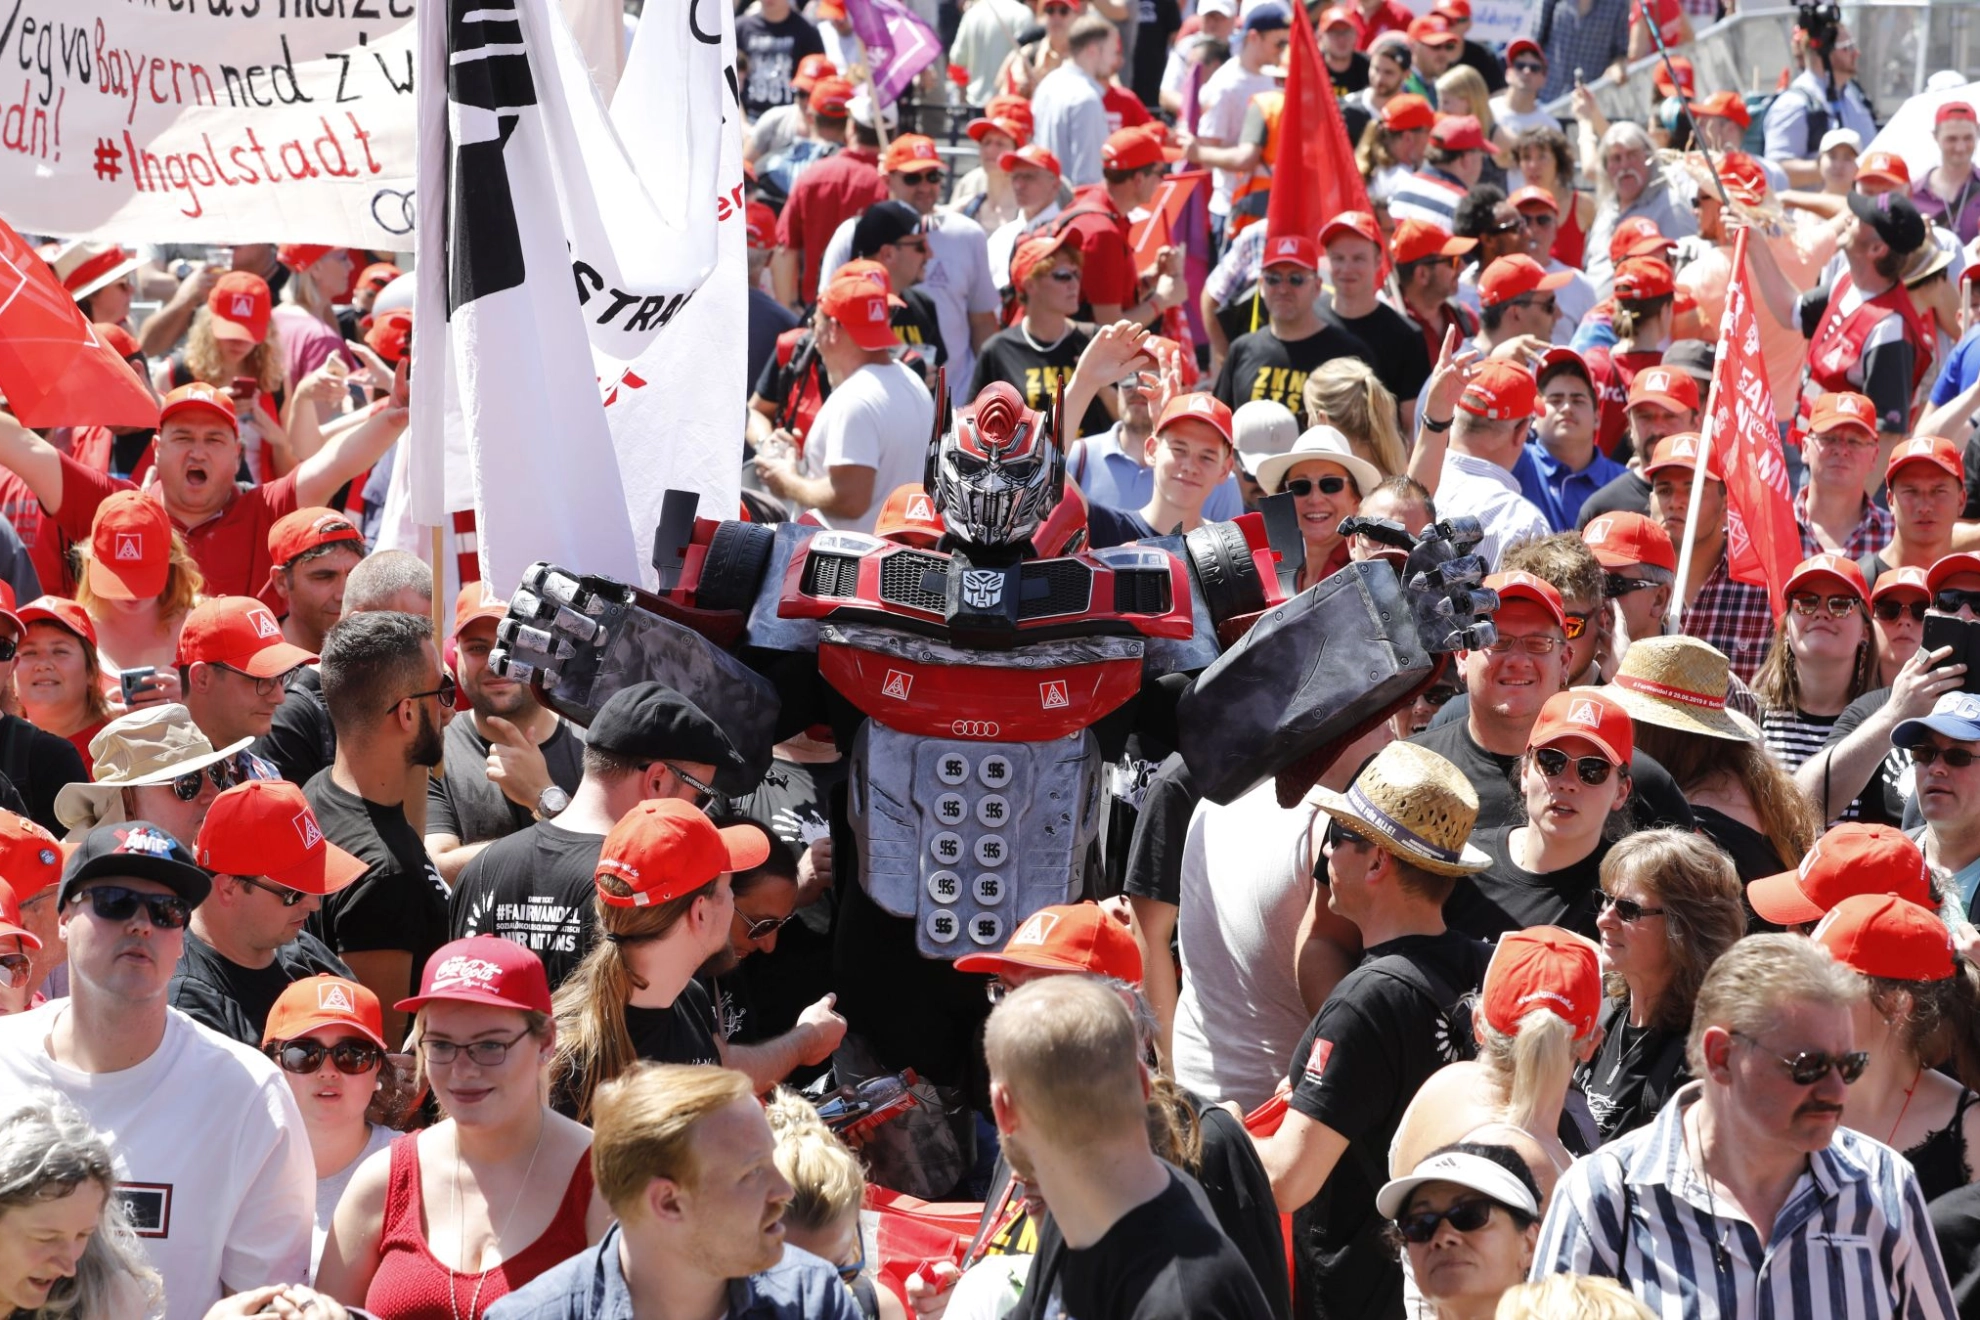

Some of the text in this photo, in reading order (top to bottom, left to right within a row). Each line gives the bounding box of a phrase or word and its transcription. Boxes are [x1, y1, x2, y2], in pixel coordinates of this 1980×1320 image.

[61, 23, 91, 84] vo
[95, 17, 216, 125] Bayern
[220, 34, 313, 107] ned
[1, 79, 65, 162] dn!
[93, 111, 382, 218] #Ingolstadt
[572, 261, 697, 332] STRA
[1375, 817, 1396, 836] ALLE!
